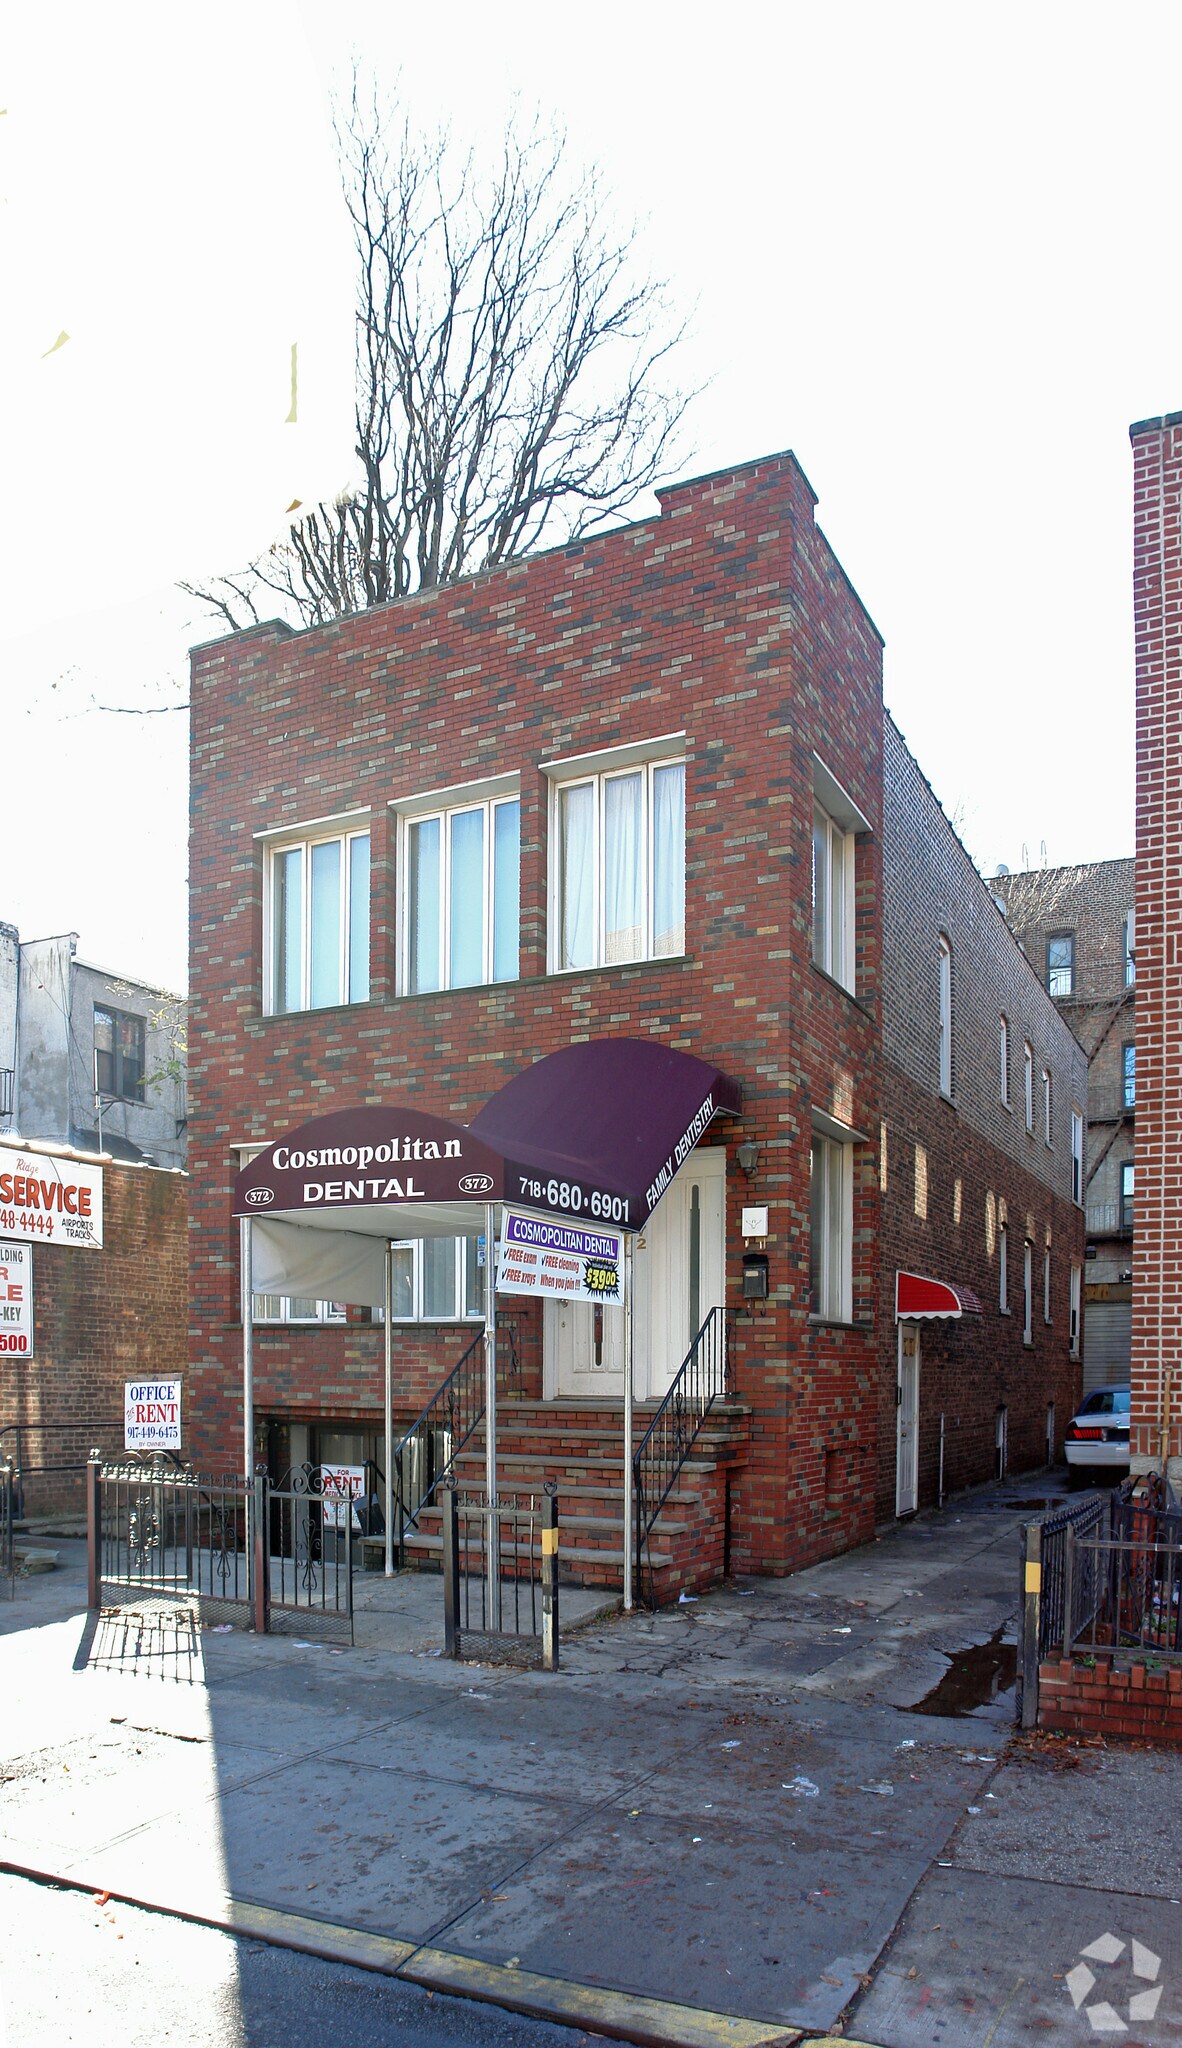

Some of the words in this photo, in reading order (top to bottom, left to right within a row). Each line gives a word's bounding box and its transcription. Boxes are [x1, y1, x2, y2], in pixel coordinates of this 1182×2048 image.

[271, 1135, 463, 1170] Cosmopolitan
[645, 1156, 674, 1211] FAMILY
[674, 1093, 714, 1166] DENTISTRY
[16, 1158, 39, 1177] Ridge
[303, 1177, 425, 1202] DENTAL
[464, 1177, 488, 1191] 372
[0, 1173, 92, 1217] SERVICE
[250, 1190, 270, 1202] 372
[0, 1208, 54, 1235] 48-4444
[61, 1218, 94, 1231] AIRPORTS
[65, 1228, 91, 1240] TRACKS
[513, 1220, 583, 1251] COSMOPOLITAN
[584, 1236, 615, 1256] DENTAL
[508, 1248, 524, 1262] FREE
[523, 1252, 537, 1265] exam
[545, 1255, 558, 1268] FREE
[558, 1257, 579, 1273] cleaning
[506, 1268, 521, 1282] FREE
[540, 1274, 554, 1287] When
[554, 1277, 564, 1289] you
[564, 1277, 574, 1291] join
[130, 1385, 175, 1401] OFFICE
[135, 1403, 178, 1423] RENT
[127, 1426, 178, 1439] 917-449-6475
[324, 1475, 362, 1489] RENT
